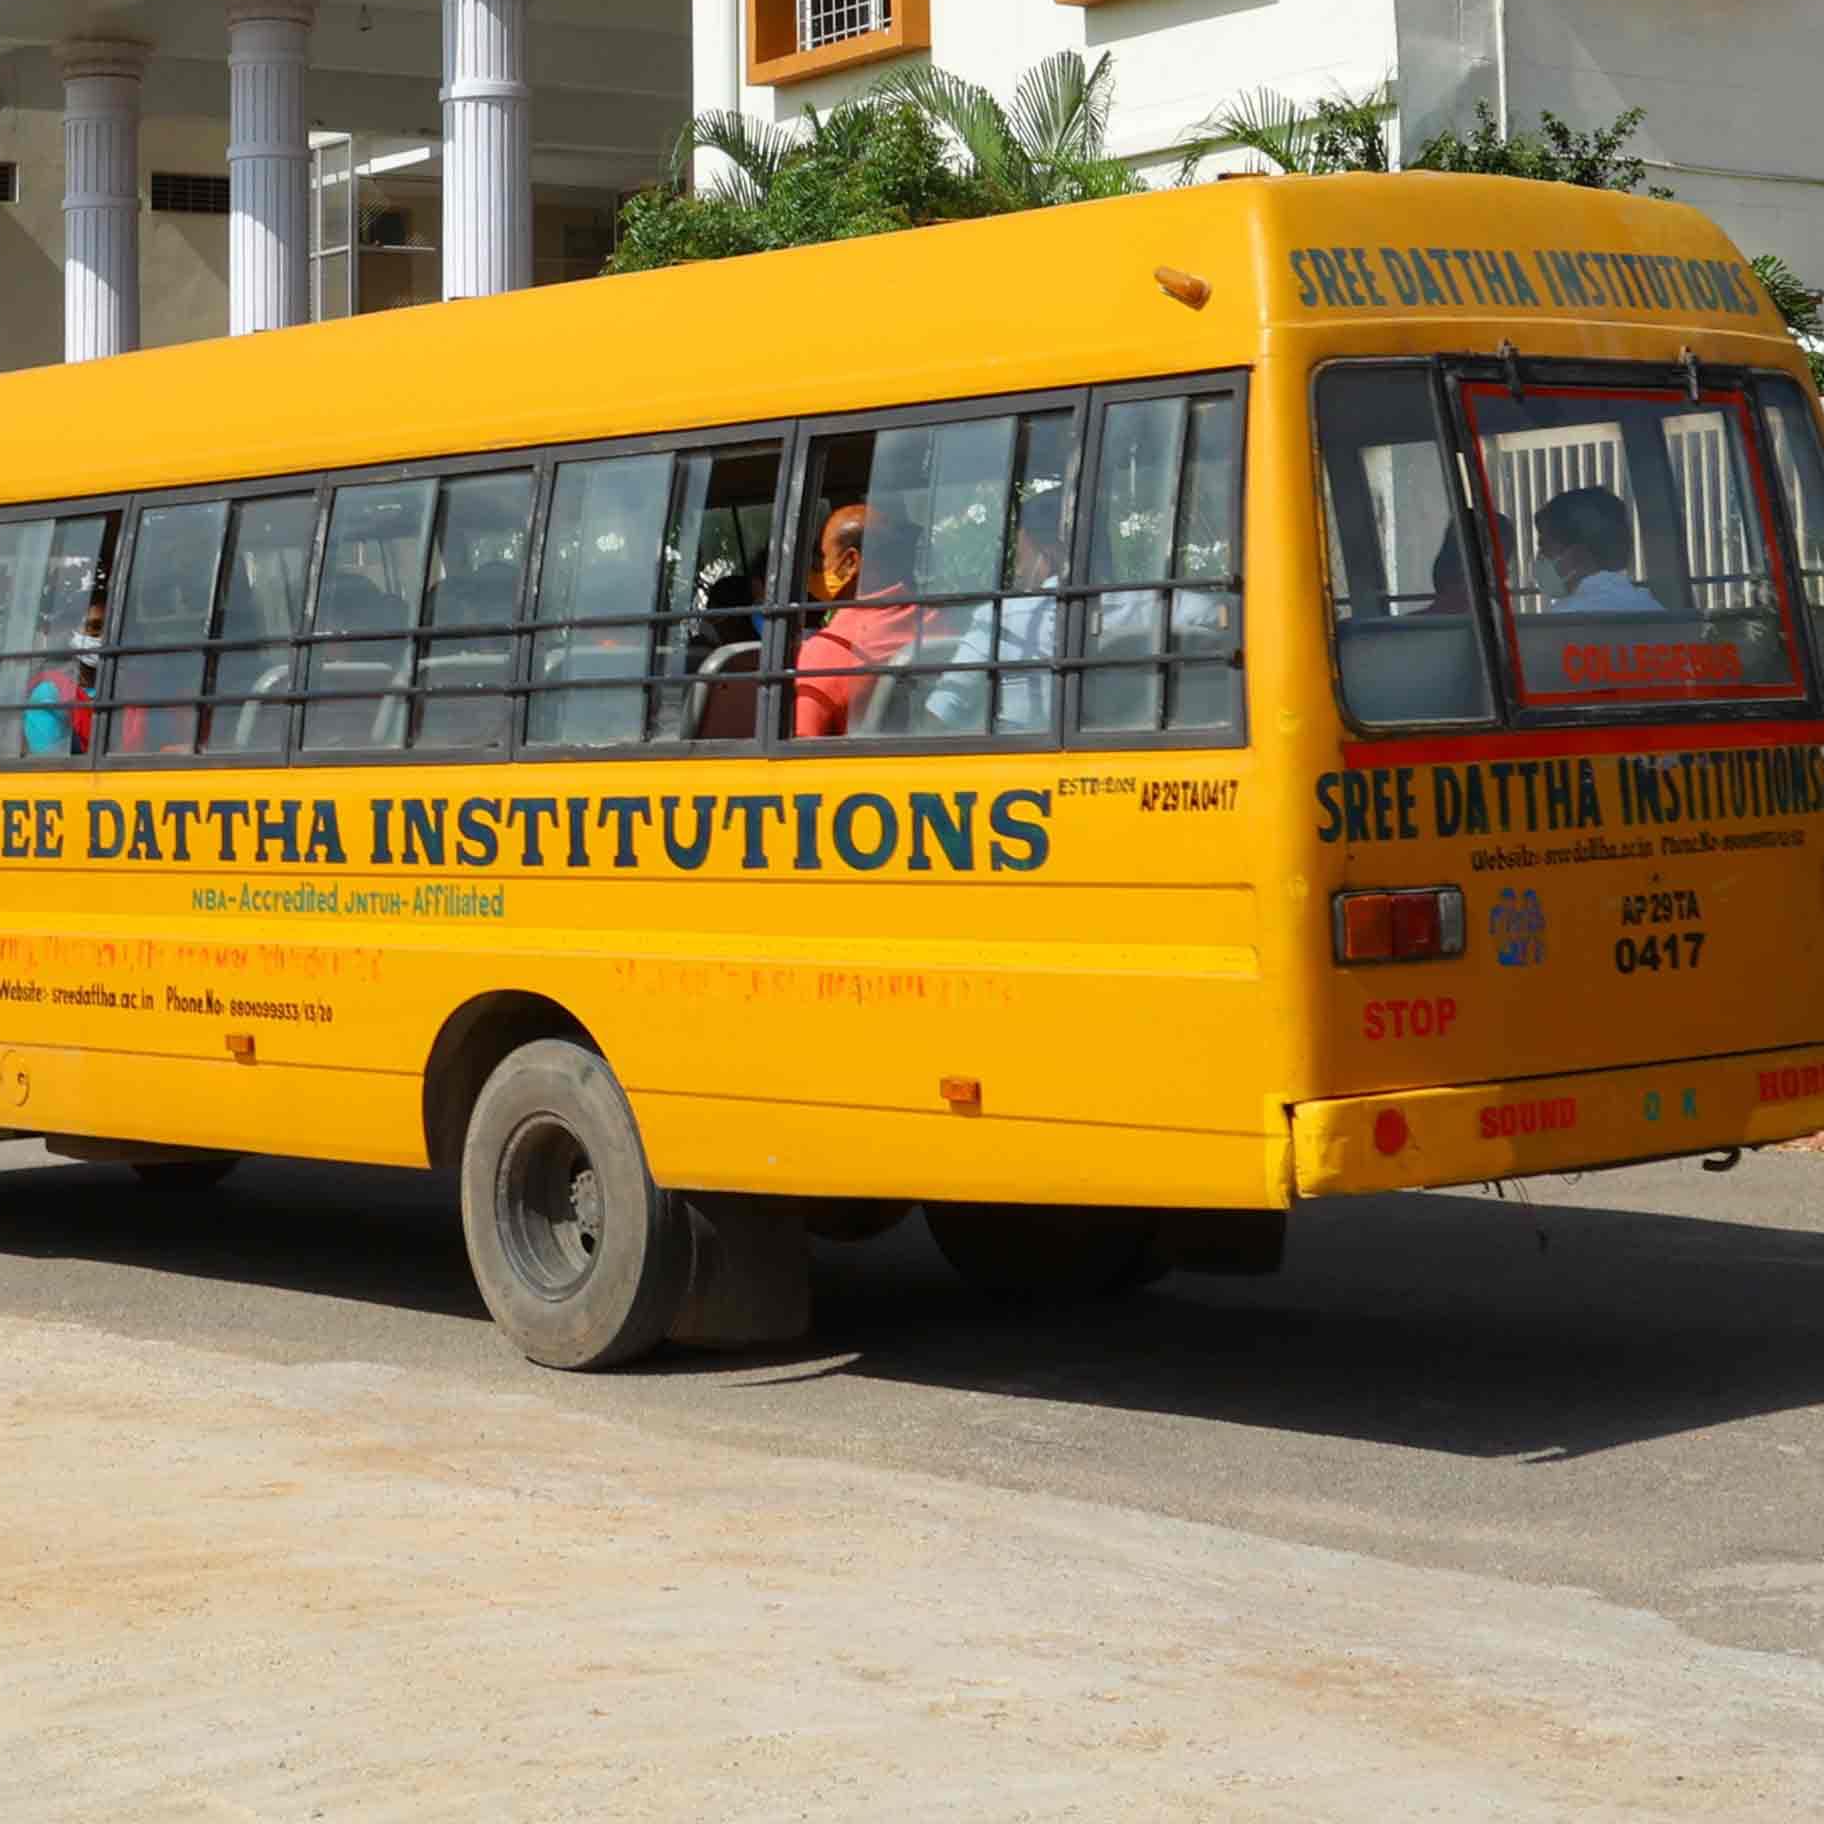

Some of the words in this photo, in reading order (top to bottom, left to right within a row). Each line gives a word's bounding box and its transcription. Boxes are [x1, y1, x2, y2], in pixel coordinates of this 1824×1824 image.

[1289, 247, 1386, 308] SREE
[1379, 247, 1541, 308] DATTHA
[1533, 249, 1760, 317] INSTITUTIONS
[1141, 779, 1239, 812] AP29TA0417
[1315, 768, 1419, 844] SREE
[1432, 757, 1602, 838] DATTHA
[1618, 745, 1824, 826] INSTITUTIONS
[87, 799, 347, 864] DATTHA
[369, 788, 1053, 873] INSTITUTIONS
[1615, 931, 1706, 975] 0417
[1362, 996, 1457, 1040] STOP
[1479, 1096, 1577, 1140] SOUND
